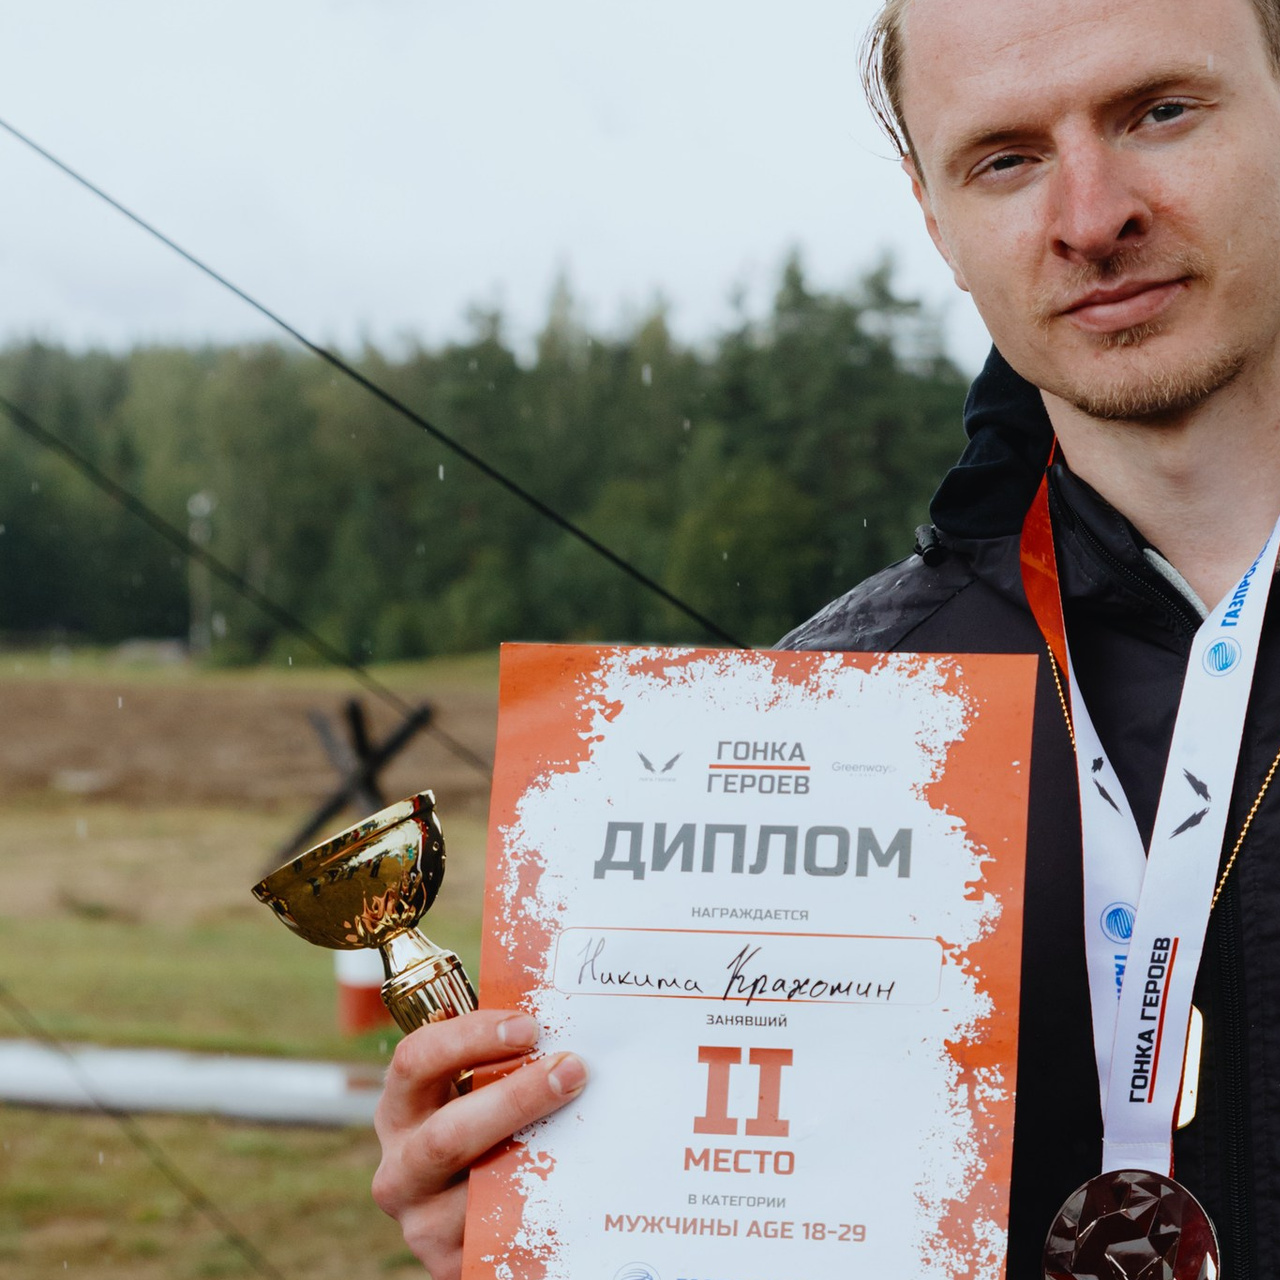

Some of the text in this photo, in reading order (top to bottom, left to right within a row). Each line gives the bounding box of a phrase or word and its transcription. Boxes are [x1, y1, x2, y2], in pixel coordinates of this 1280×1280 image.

[716, 740, 806, 762] ГОНКА
[831, 761, 889, 775] Greenway
[707, 773, 810, 795] ГЕРОЕВ
[593, 821, 913, 880] ДИПЛОМ
[691, 906, 809, 921] НАГРАЖДАЕТСЯ
[577, 937, 704, 993] Никита
[706, 1013, 787, 1027] ЗАНЯВШИЙ
[1129, 937, 1171, 1103] ГОНКА ГЕРОЕВ
[693, 1045, 794, 1137] II
[683, 1147, 795, 1176] МЕСТО
[688, 1194, 786, 1209] В КАТЕГОРИИ
[604, 1214, 866, 1242] МУЖЧИНЫ AGE 18-29
